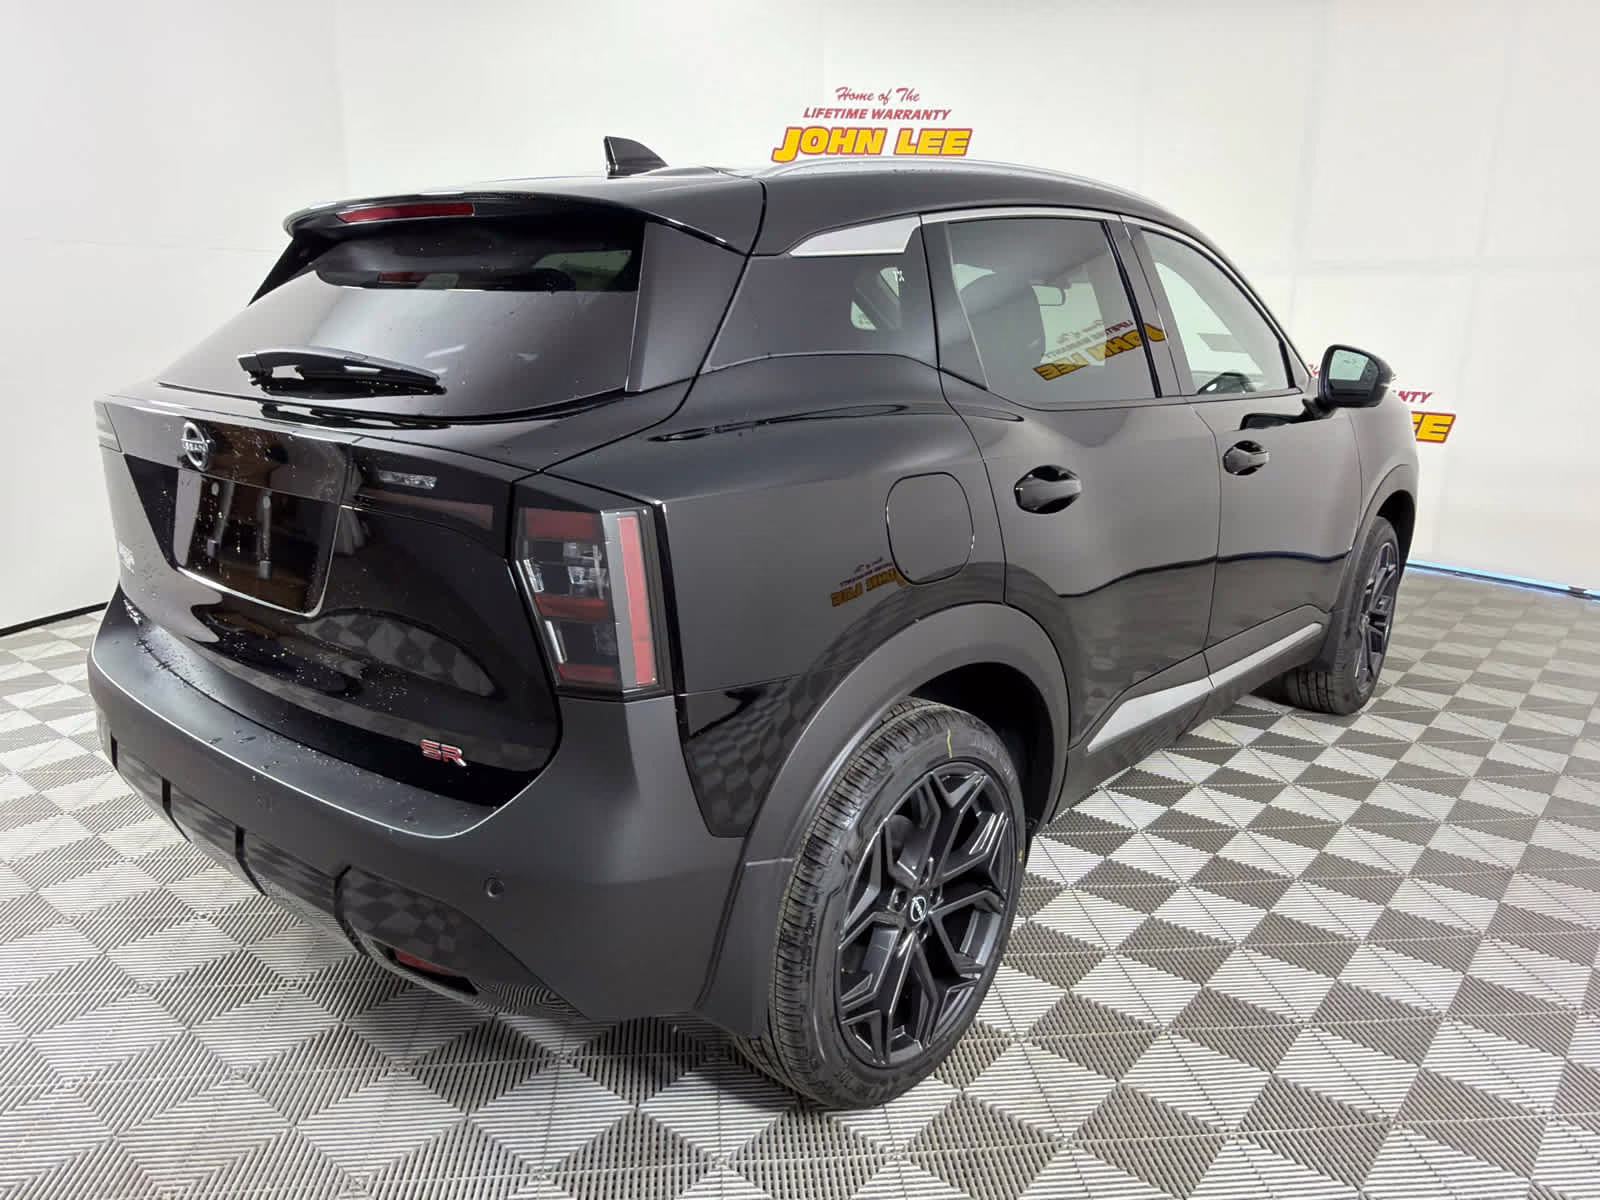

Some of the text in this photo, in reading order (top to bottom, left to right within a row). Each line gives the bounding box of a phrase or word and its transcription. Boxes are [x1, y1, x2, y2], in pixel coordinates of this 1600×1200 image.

[835, 86, 921, 105] Home of The
[803, 107, 952, 121] LIFETIME WARRANTY
[771, 126, 973, 164] JOHN LEE
[421, 739, 467, 767] SR
